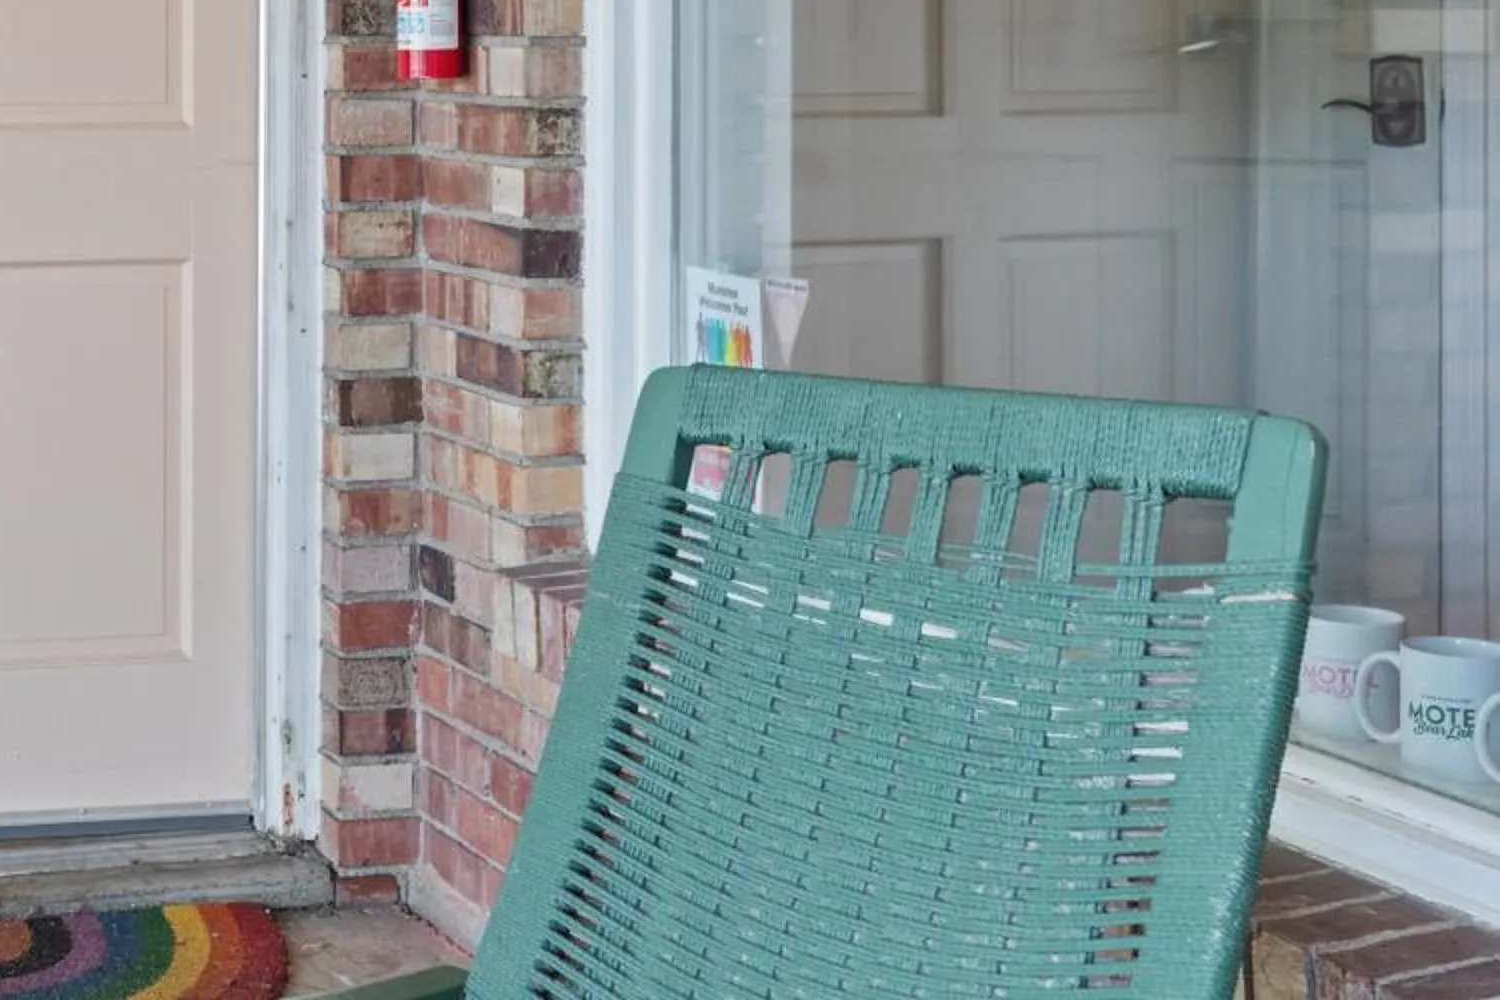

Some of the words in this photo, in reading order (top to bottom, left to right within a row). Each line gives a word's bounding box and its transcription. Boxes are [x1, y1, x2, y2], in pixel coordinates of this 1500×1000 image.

[1304, 664, 1380, 689] MOTL
[1408, 700, 1477, 729] MOTE
[1445, 724, 1476, 741] Lak
